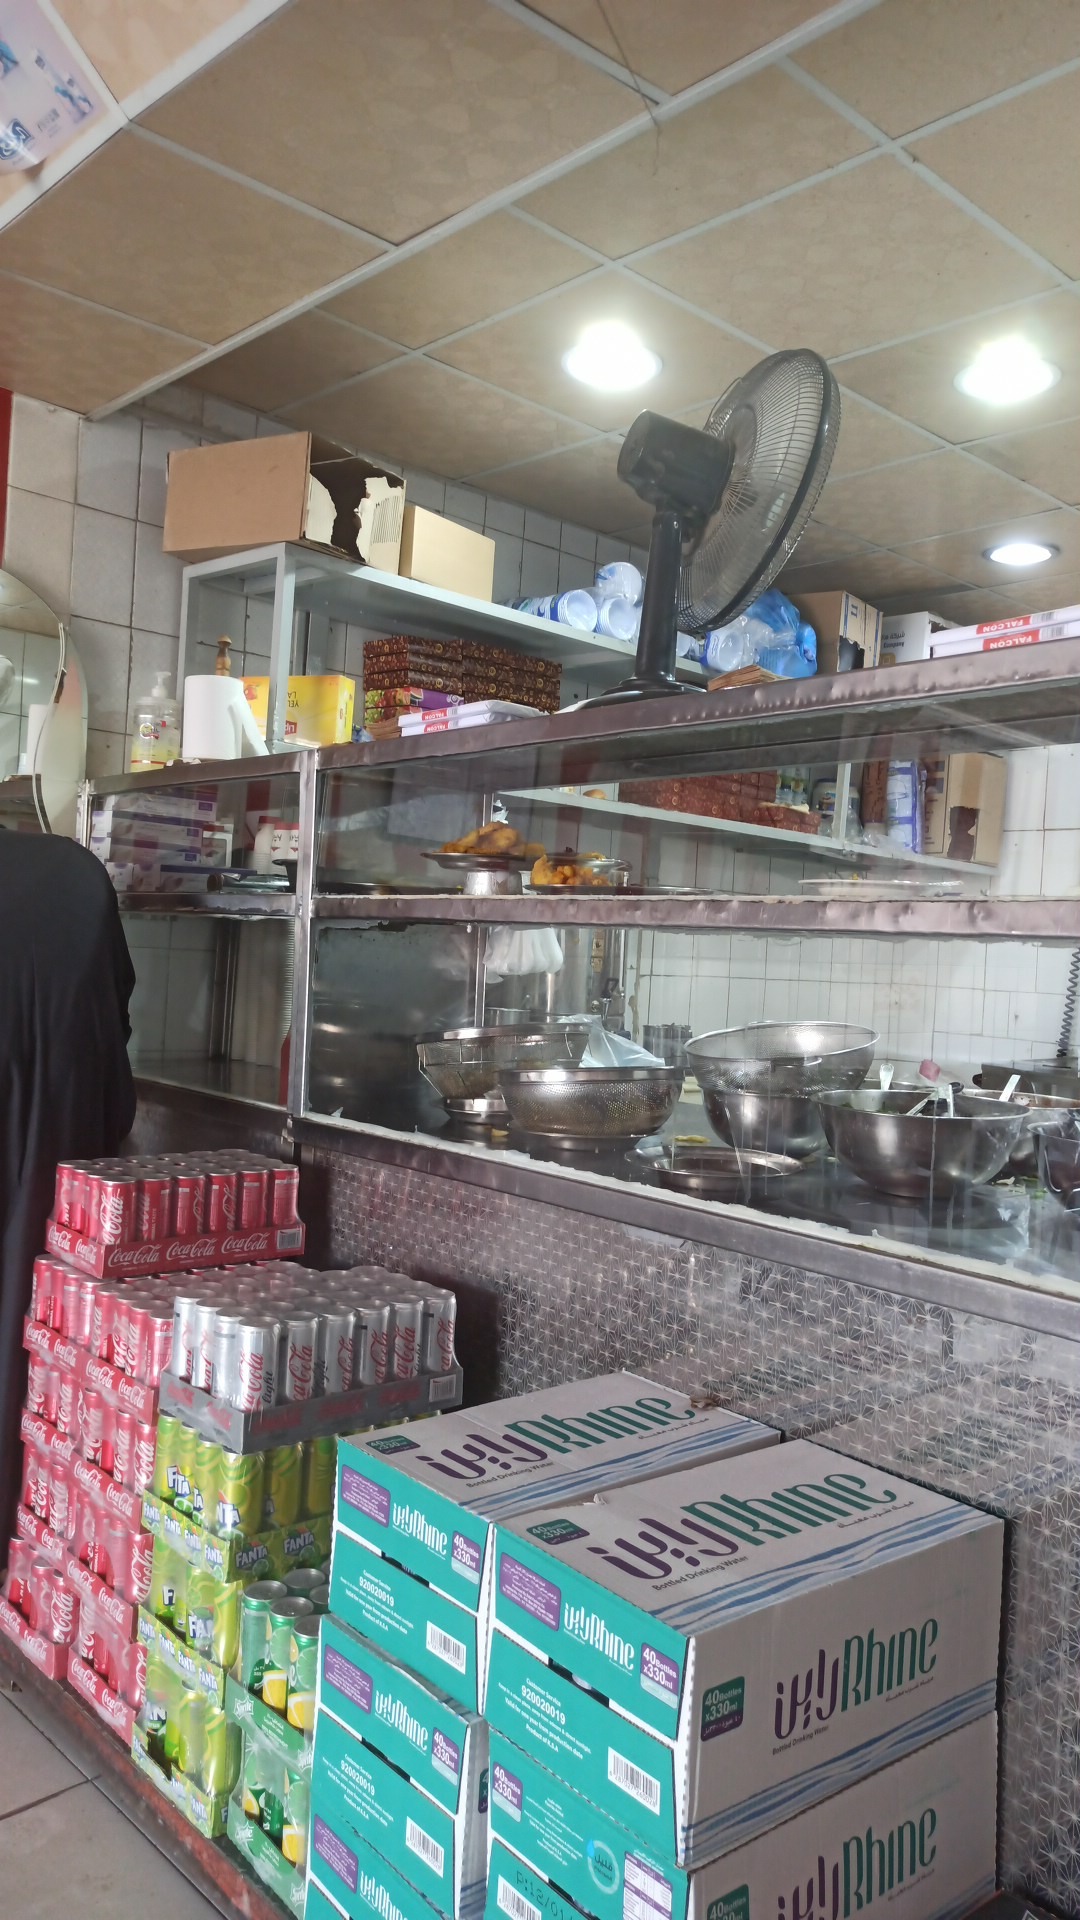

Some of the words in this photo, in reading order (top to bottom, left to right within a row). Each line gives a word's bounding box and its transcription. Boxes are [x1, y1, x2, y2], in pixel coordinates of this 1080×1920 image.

[983, 619, 1024, 633] FALCON
[990, 635, 1032, 649] FALCON
[108, 1244, 161, 1267] Coca-Cola
[505, 1396, 695, 1455] Rhine
[466, 1476, 497, 1488] Bottled
[497, 1467, 532, 1480] Drinking
[681, 1473, 898, 1546] Rhine
[284, 1531, 315, 1553] FANTA
[413, 1509, 448, 1555] Rhine
[235, 1545, 269, 1567] FANTA
[652, 1576, 688, 1591] Bottled
[686, 1563, 724, 1580] Drinking
[723, 1555, 749, 1569] Water
[359, 1576, 395, 1607] 920020019
[589, 1612, 635, 1671] Rhine
[841, 1618, 938, 1713] Rhine
[521, 1684, 567, 1726] 920020019
[395, 1699, 429, 1751] Rhine
[772, 1742, 792, 1756] Bottled
[792, 1732, 814, 1745] Drinking
[814, 1725, 829, 1736] Water
[340, 1759, 376, 1796] 920020019
[842, 1808, 937, 1918] Rhine
